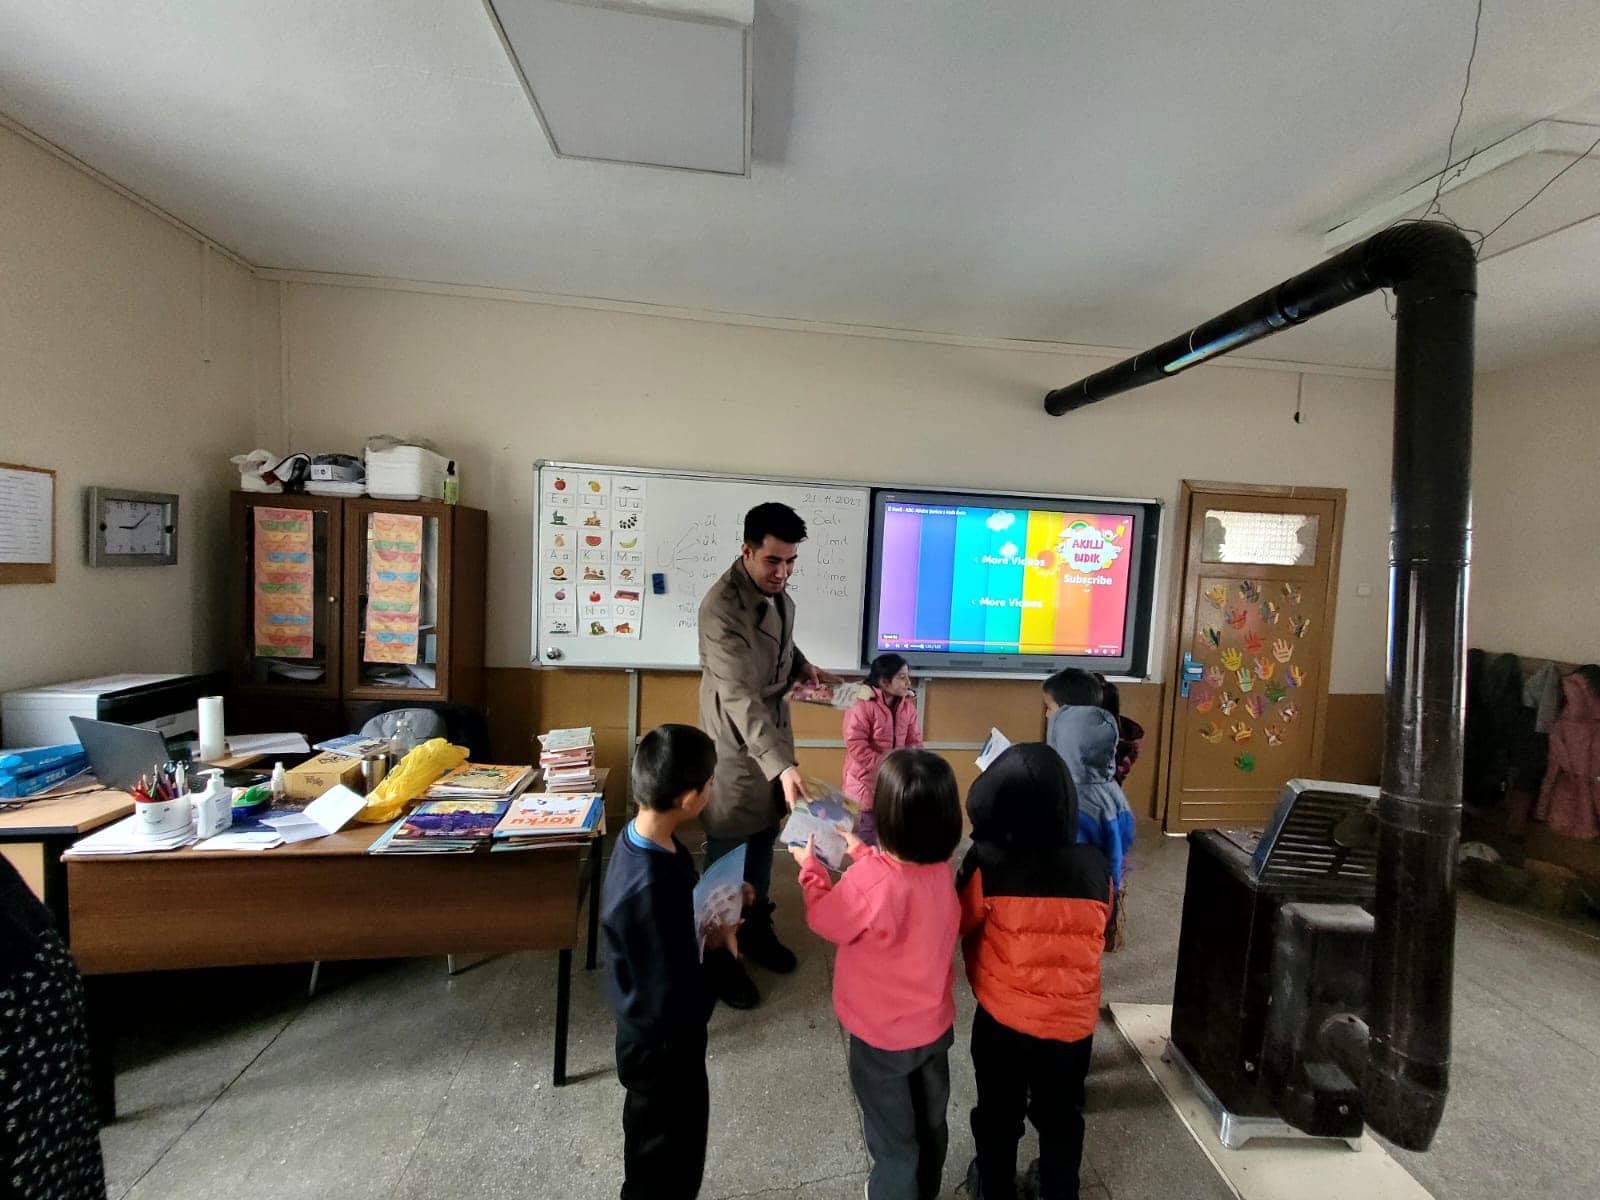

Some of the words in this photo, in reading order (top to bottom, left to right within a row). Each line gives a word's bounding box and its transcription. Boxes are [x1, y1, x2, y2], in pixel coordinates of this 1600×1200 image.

[982, 554, 1009, 565] More
[1011, 556, 1046, 567] Videos
[1063, 573, 1113, 586] Subscribe
[979, 596, 1006, 607] More
[1008, 598, 1043, 609] Videos
